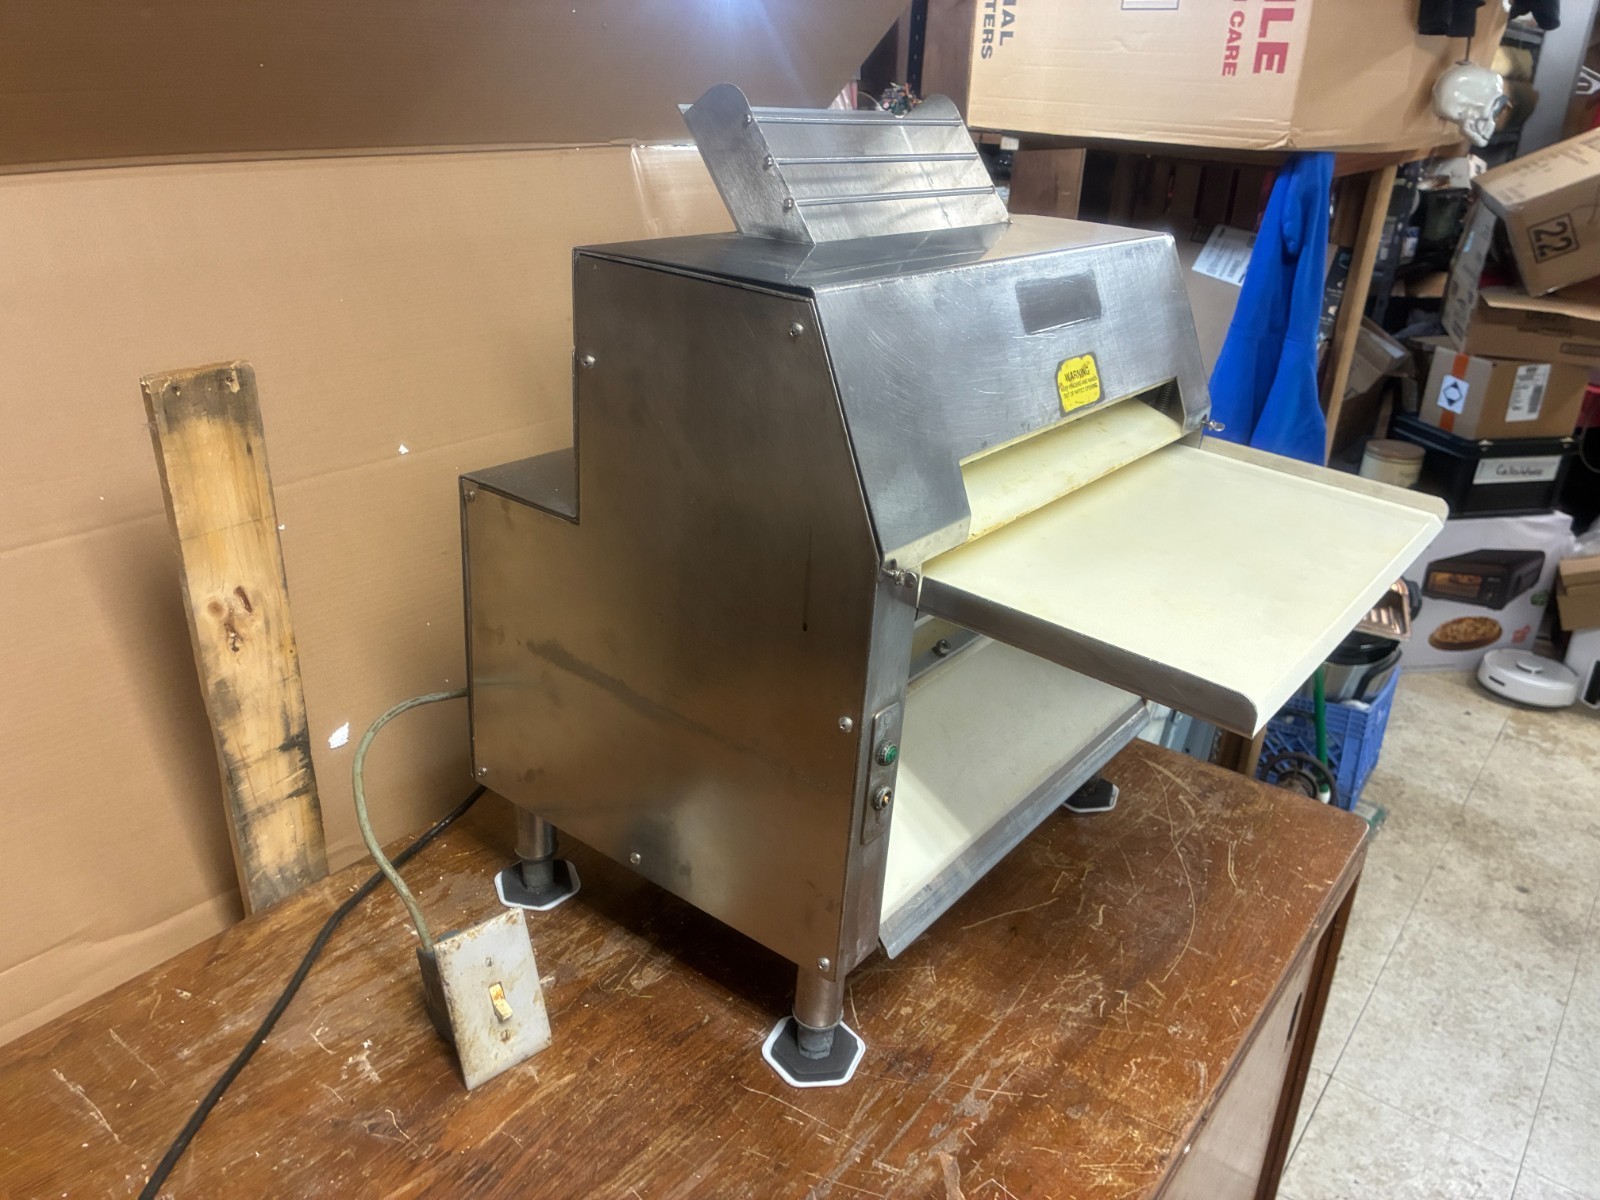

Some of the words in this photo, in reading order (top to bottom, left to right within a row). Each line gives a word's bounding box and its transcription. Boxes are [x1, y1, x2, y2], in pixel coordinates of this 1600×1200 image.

[981, 0, 996, 60] TERS
[1222, 10, 1245, 76] CARE
[1252, 0, 1296, 74] LE
[1533, 221, 1572, 257] 22
[1064, 366, 1090, 382] WARNING
